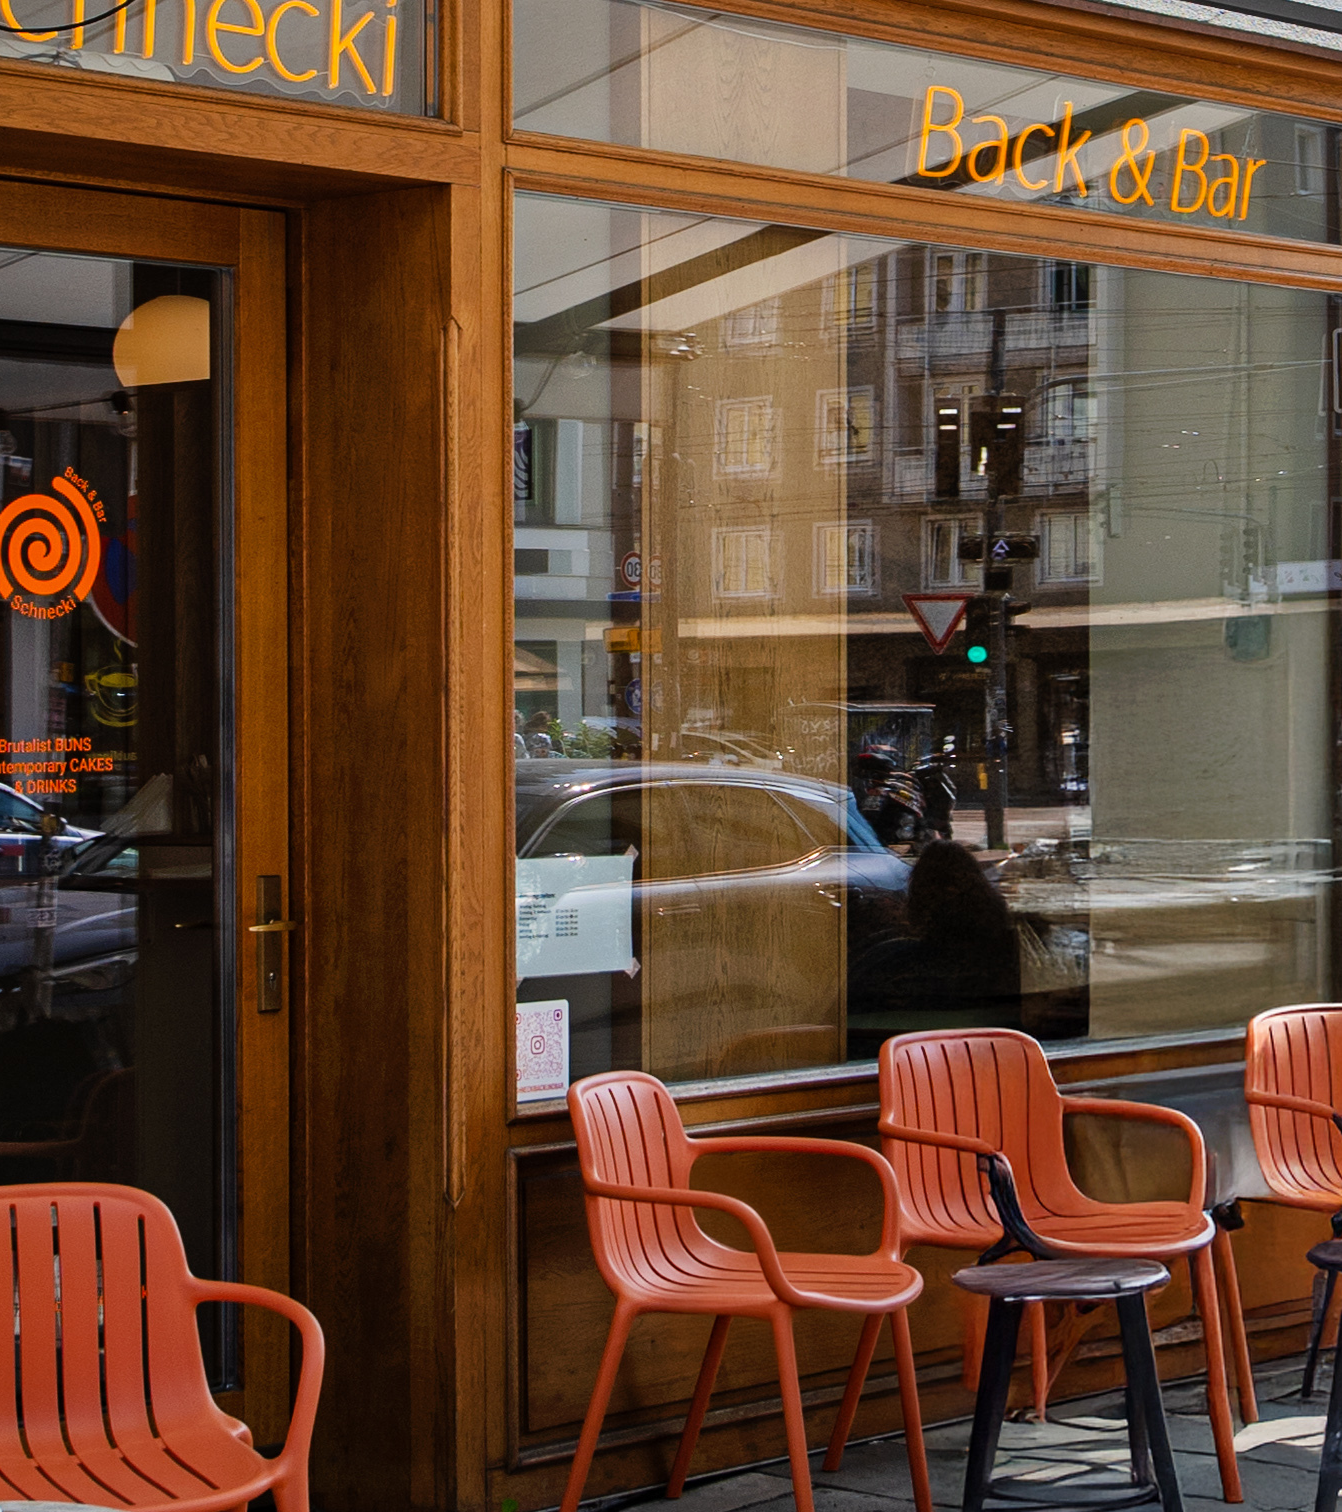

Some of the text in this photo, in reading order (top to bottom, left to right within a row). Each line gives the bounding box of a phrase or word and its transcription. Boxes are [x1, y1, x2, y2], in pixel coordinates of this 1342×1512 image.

[917, 84, 1267, 221] Back & Bar
[64, 466, 107, 523] Back & Bar
[10, 595, 77, 620] Schnecki
[54, 737, 92, 752] BUNS
[69, 757, 114, 772] CAKES
[14, 778, 77, 795] & DRINKS
